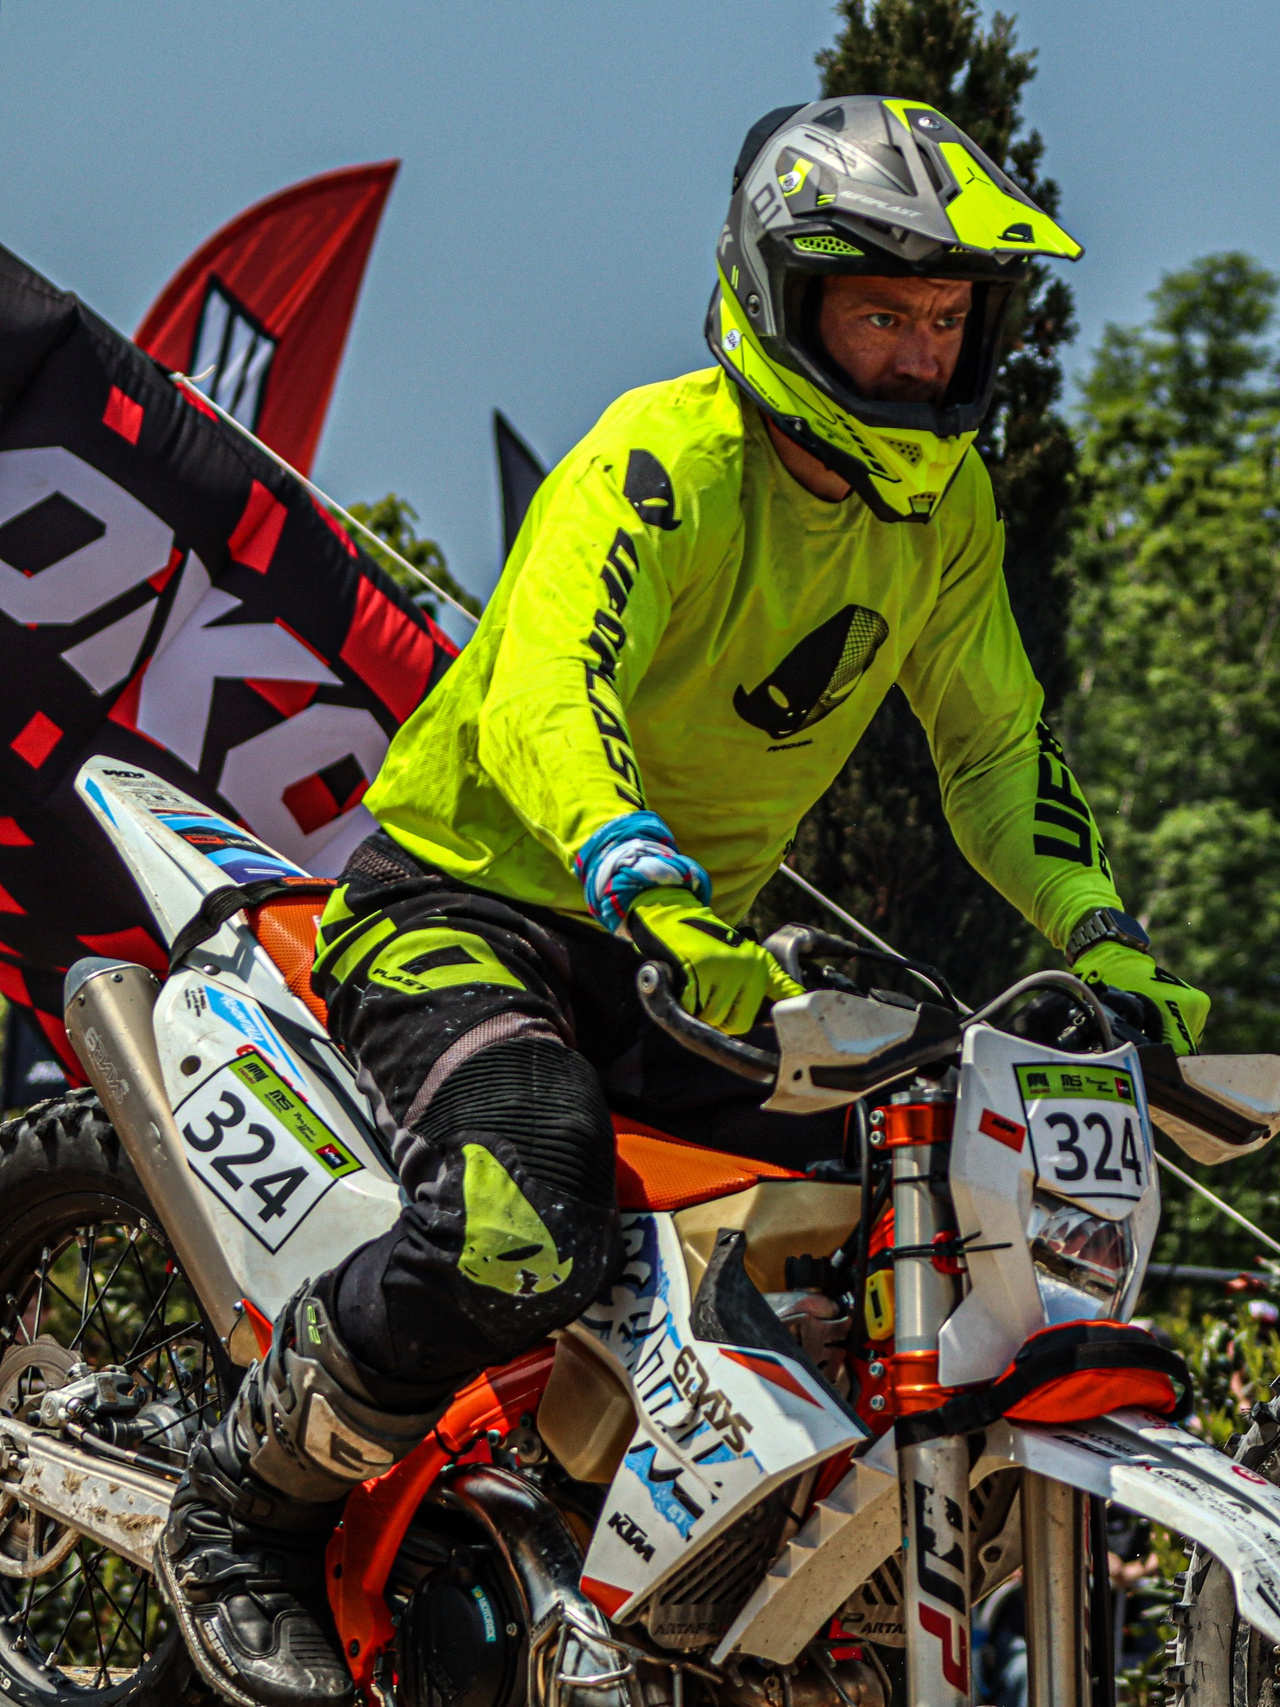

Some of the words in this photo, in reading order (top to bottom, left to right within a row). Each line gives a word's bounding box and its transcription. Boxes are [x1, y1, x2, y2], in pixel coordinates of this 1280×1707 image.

[371, 968, 433, 991] PLAST
[182, 1090, 310, 1223] 324
[1045, 1112, 1142, 1186] 324
[671, 1344, 754, 1453] 6DAYS
[1155, 1469, 1199, 1493] KENDA
[607, 1511, 656, 1563] KTM
[479, 1598, 494, 1639] MOTOREX
[859, 1622, 907, 1635] ARTA
